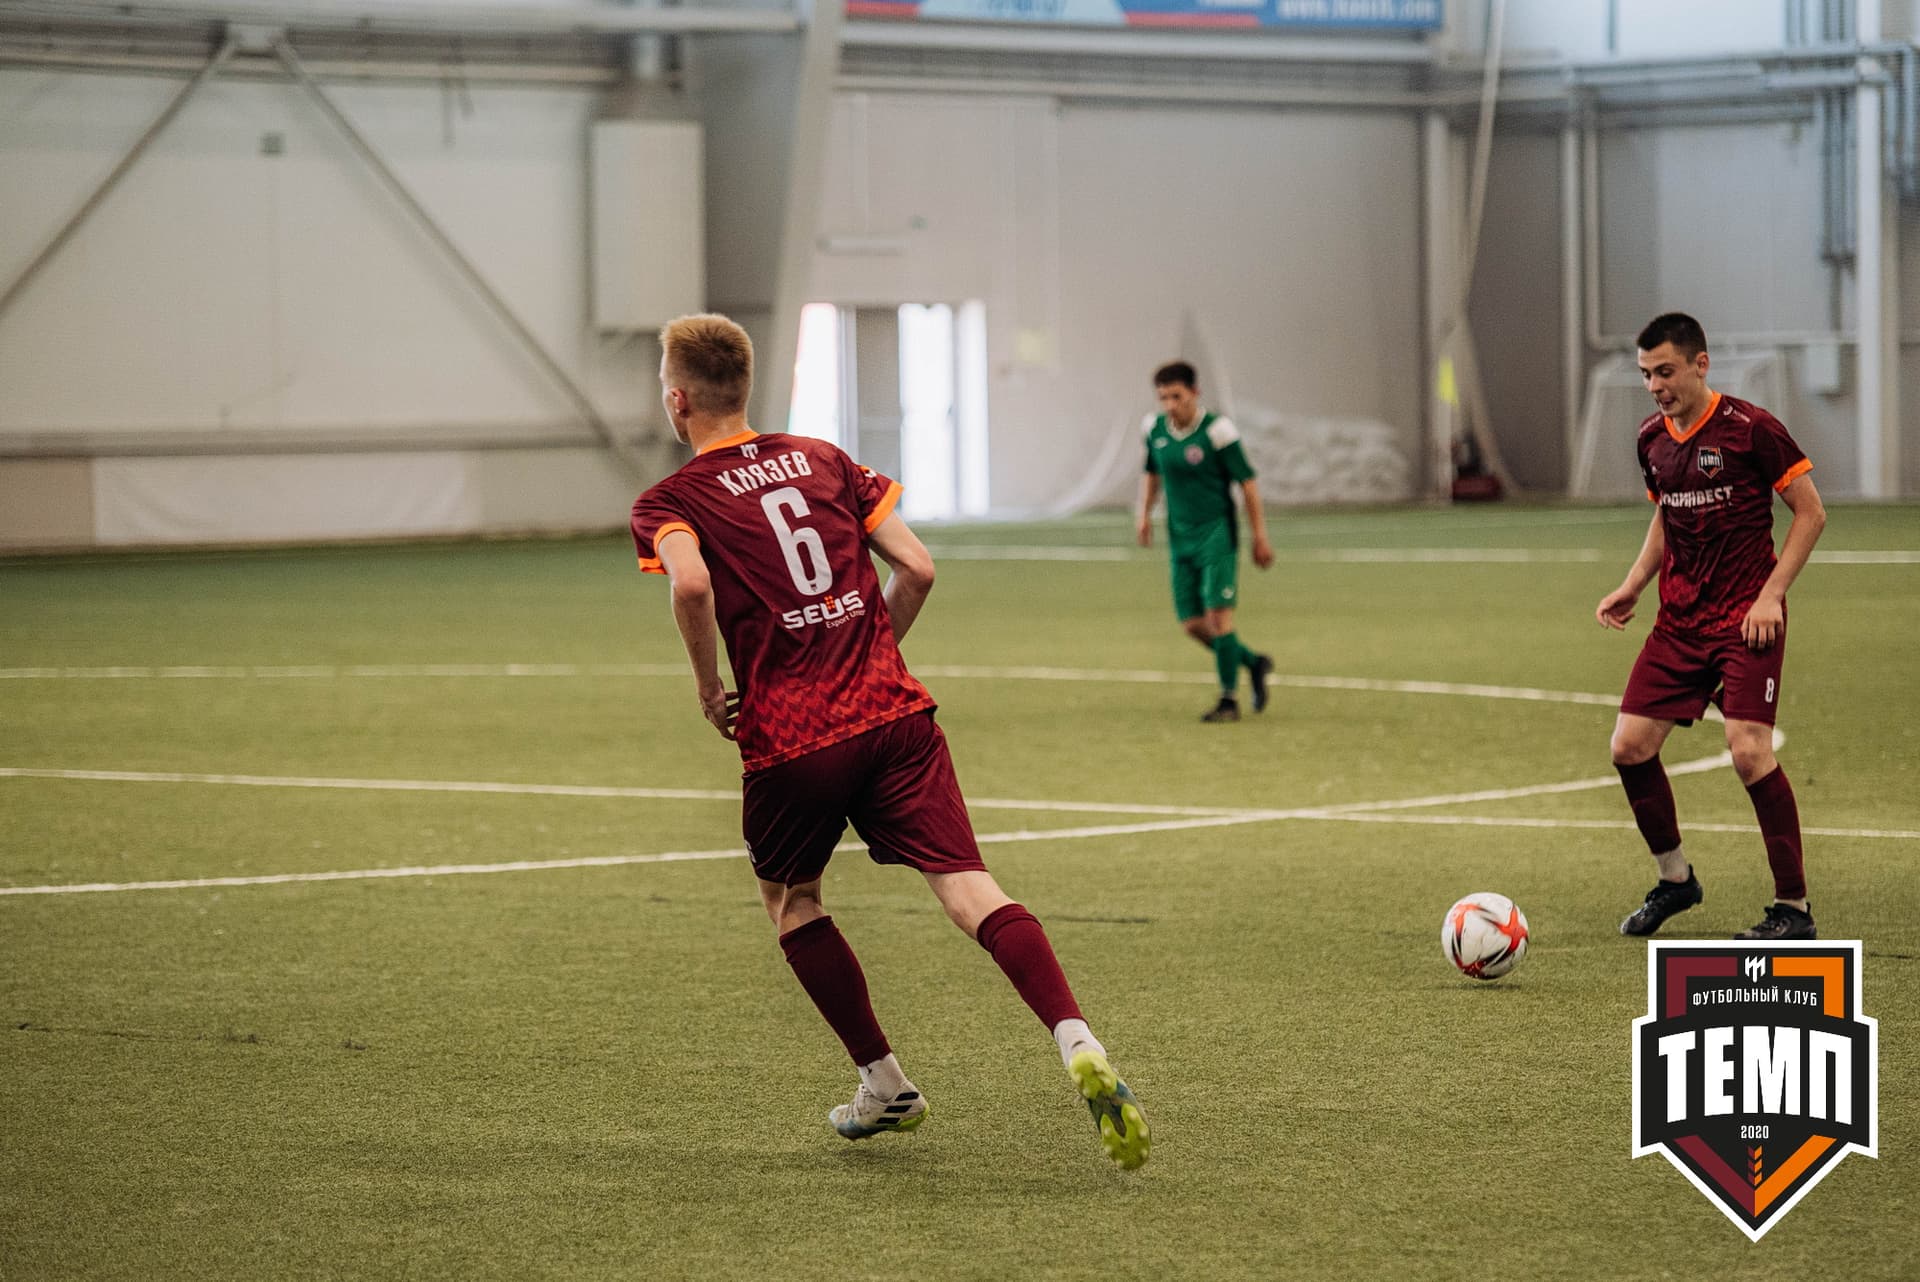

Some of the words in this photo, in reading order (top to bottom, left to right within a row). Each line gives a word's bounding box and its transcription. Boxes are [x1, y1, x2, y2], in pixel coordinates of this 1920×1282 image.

[716, 451, 812, 496] КНЯЗЕВ
[760, 486, 832, 596] 6
[1765, 677, 1775, 703] 8
